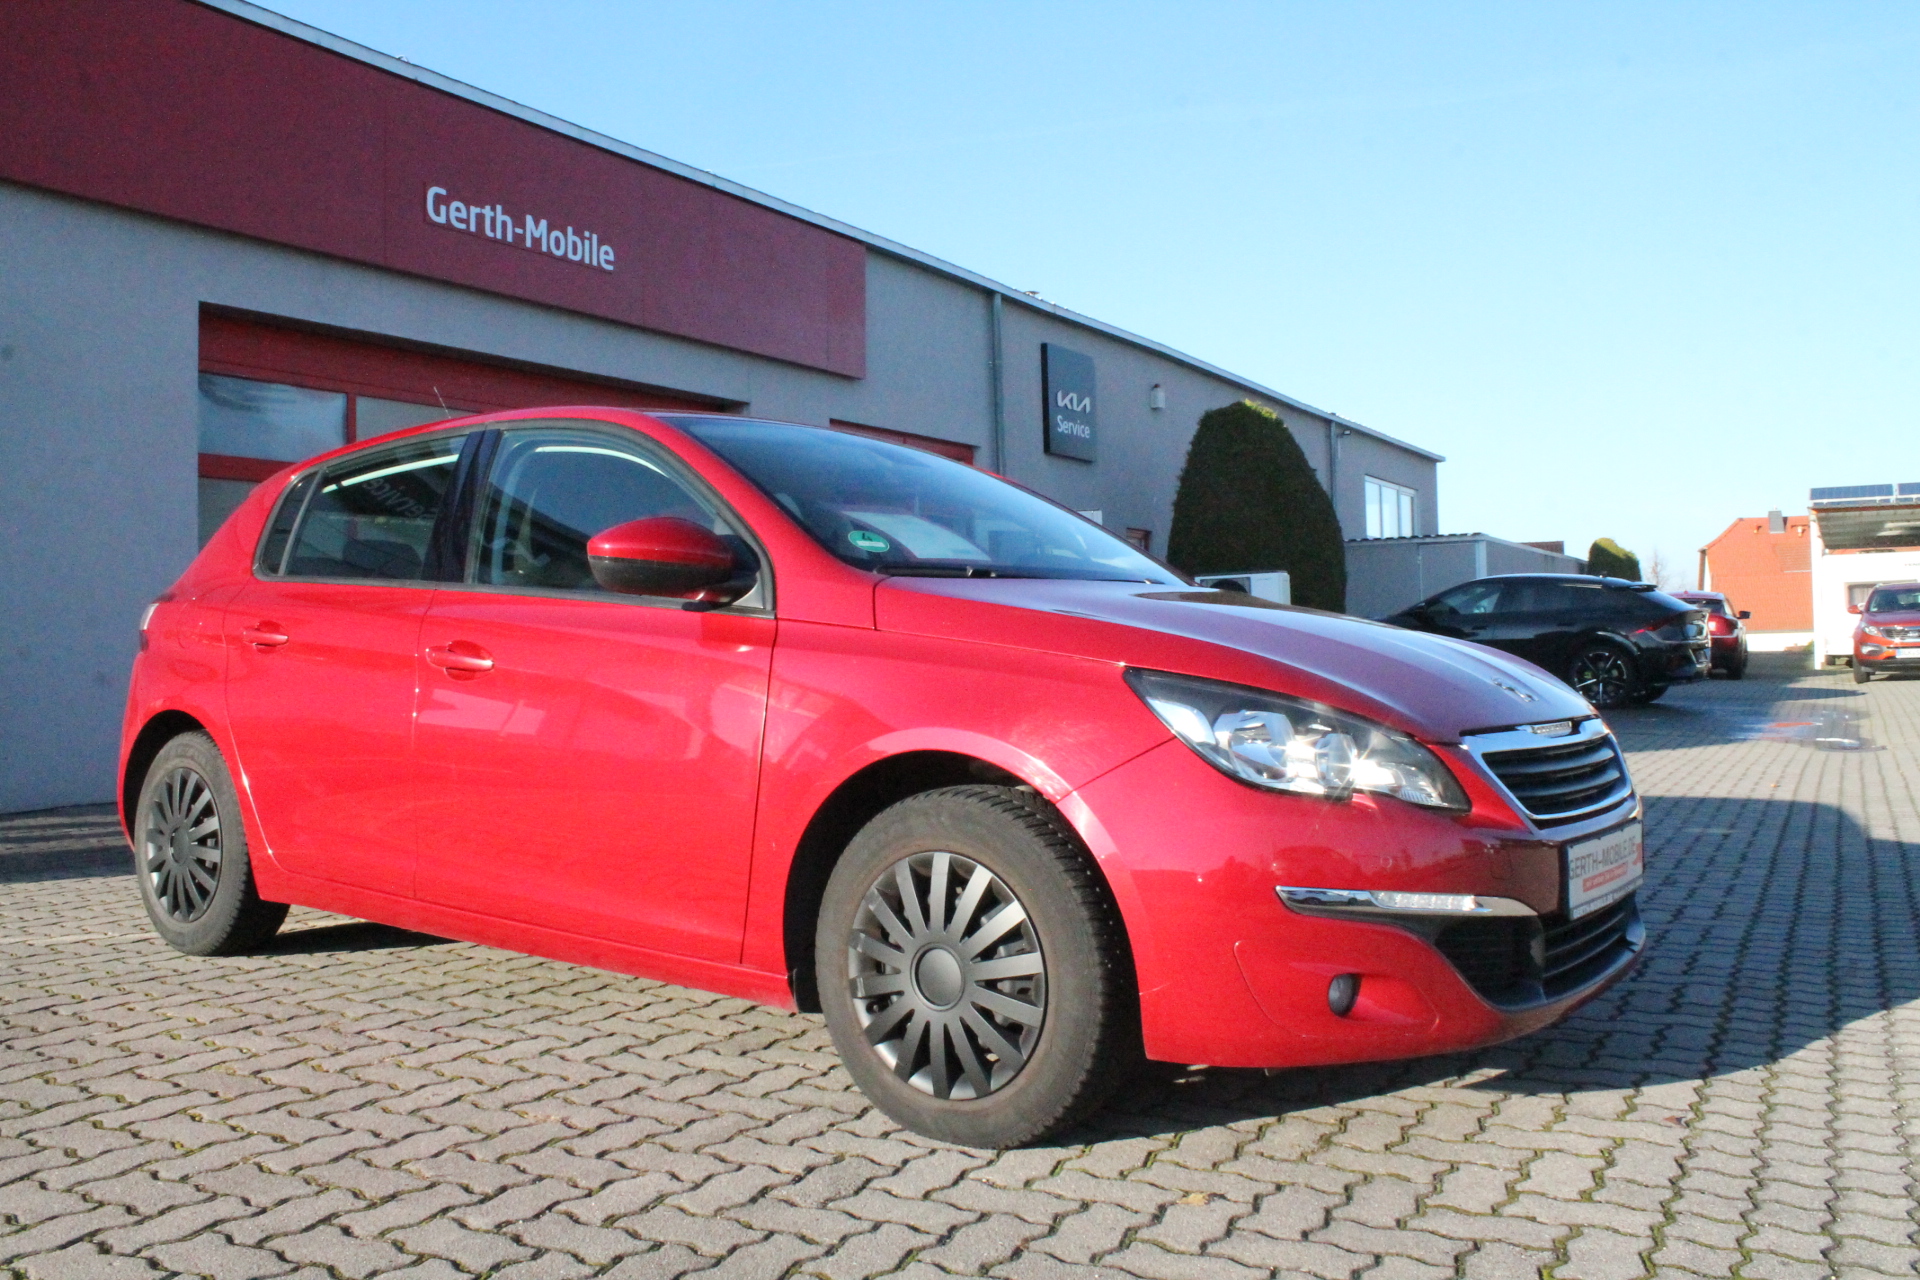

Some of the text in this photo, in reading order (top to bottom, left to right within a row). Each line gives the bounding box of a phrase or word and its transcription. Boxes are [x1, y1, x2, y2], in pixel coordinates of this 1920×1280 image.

[426, 186, 615, 271] Gerth-Mobile
[1057, 390, 1091, 414] KIA
[1057, 415, 1091, 438] Service
